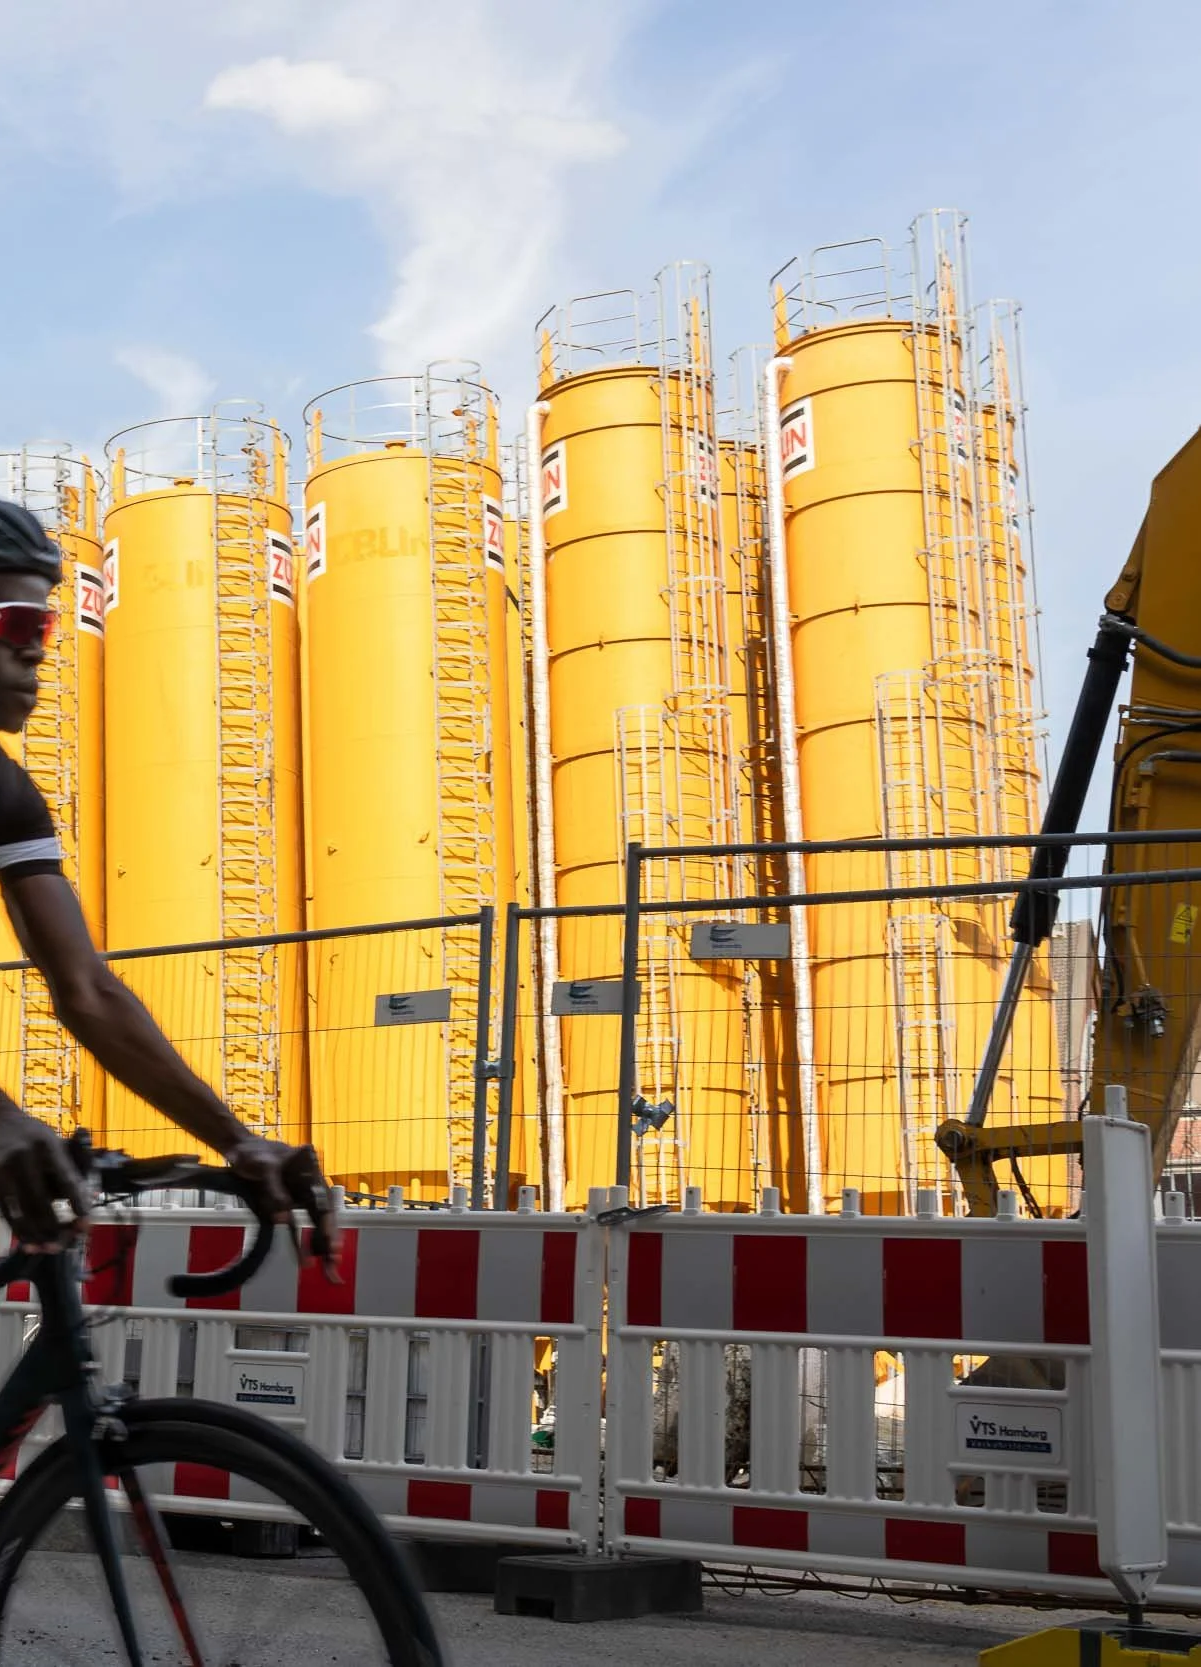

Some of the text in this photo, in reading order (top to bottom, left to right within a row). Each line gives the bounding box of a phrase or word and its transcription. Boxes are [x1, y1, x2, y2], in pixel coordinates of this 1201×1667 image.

[239, 1373, 294, 1394] VTS Hamburg
[969, 1415, 1048, 1441] VTS Hamburg
